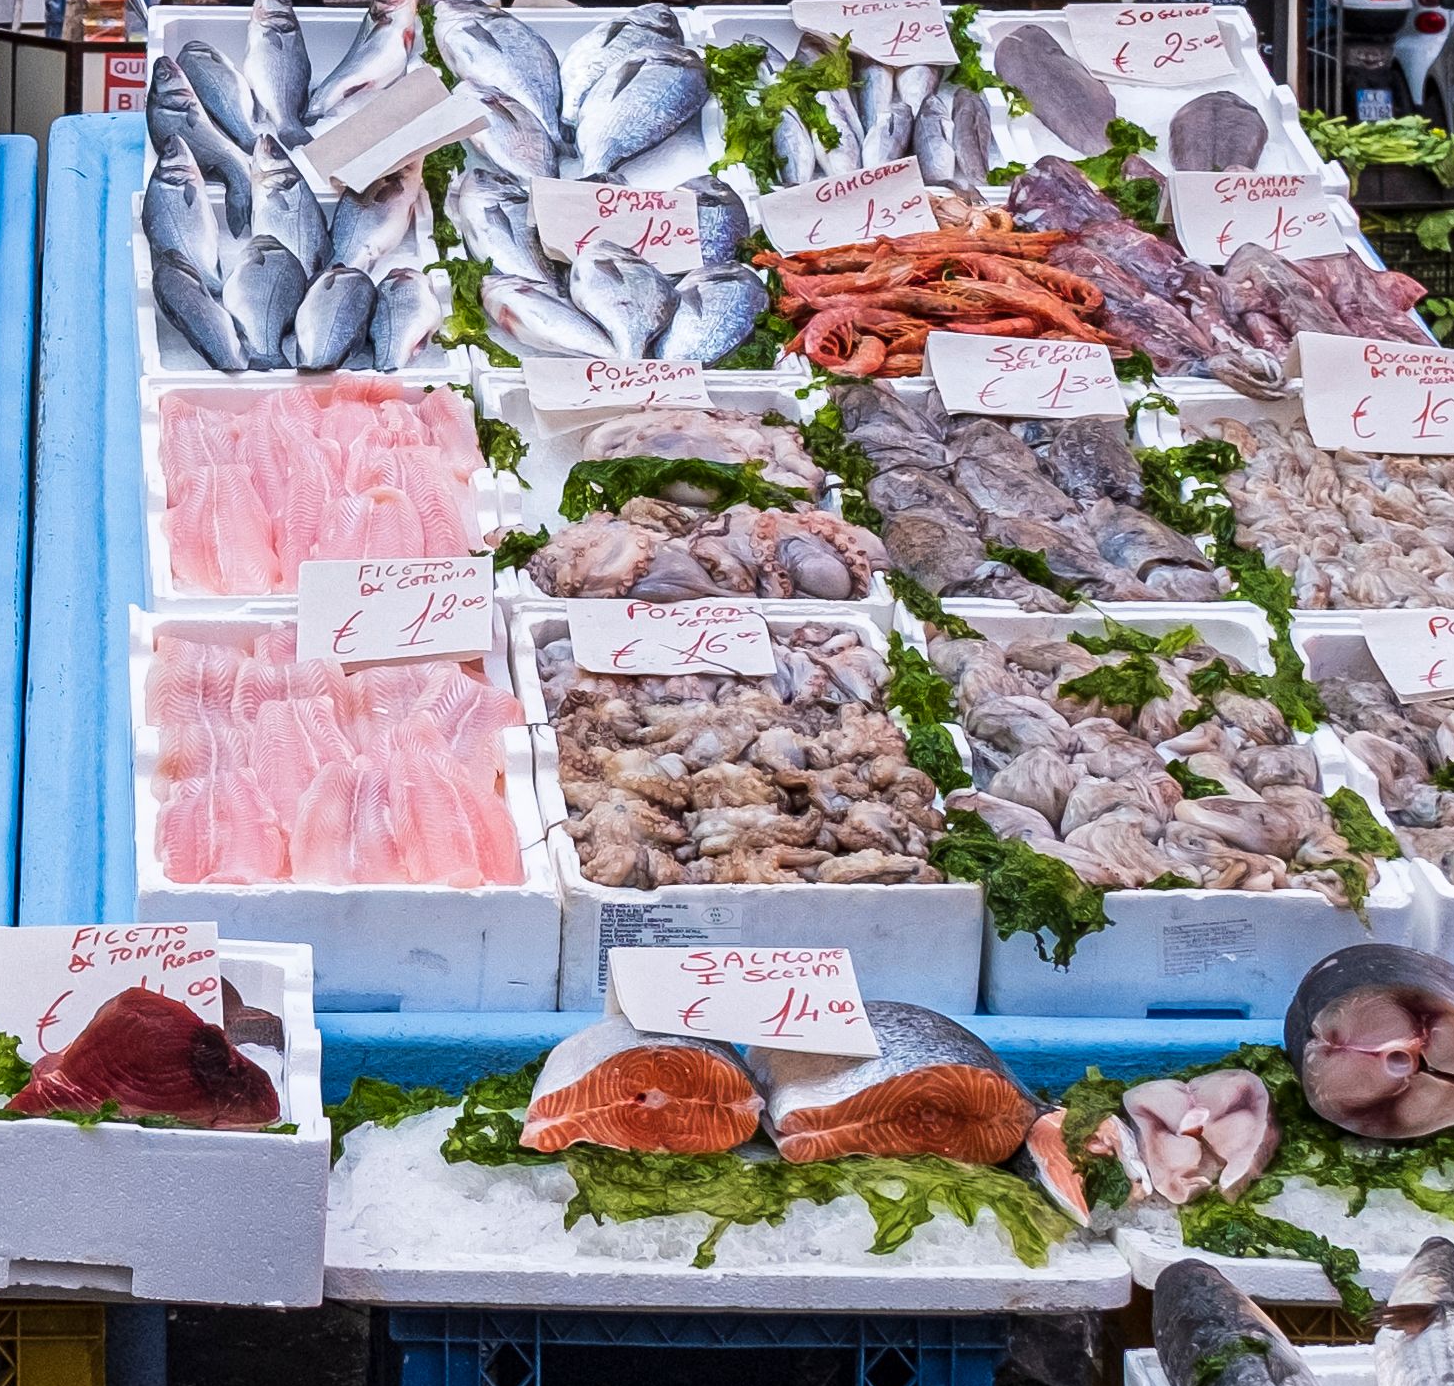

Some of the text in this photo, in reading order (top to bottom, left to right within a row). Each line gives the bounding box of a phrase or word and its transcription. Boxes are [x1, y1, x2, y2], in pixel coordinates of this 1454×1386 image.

[1111, 41, 1135, 74] €
[808, 218, 828, 245] €
[1216, 219, 1235, 256] €
[976, 376, 1009, 409] €
[1350, 395, 1377, 439] €
[333, 609, 367, 655] €
[610, 637, 642, 669] €
[1419, 658, 1448, 690] €
[71, 925, 188, 951] FILETTO
[109, 939, 188, 966] TONNO
[162, 947, 216, 972] ROSSO
[679, 949, 845, 974] SALMONE
[35, 990, 75, 1056] €
[677, 995, 718, 1033] €
